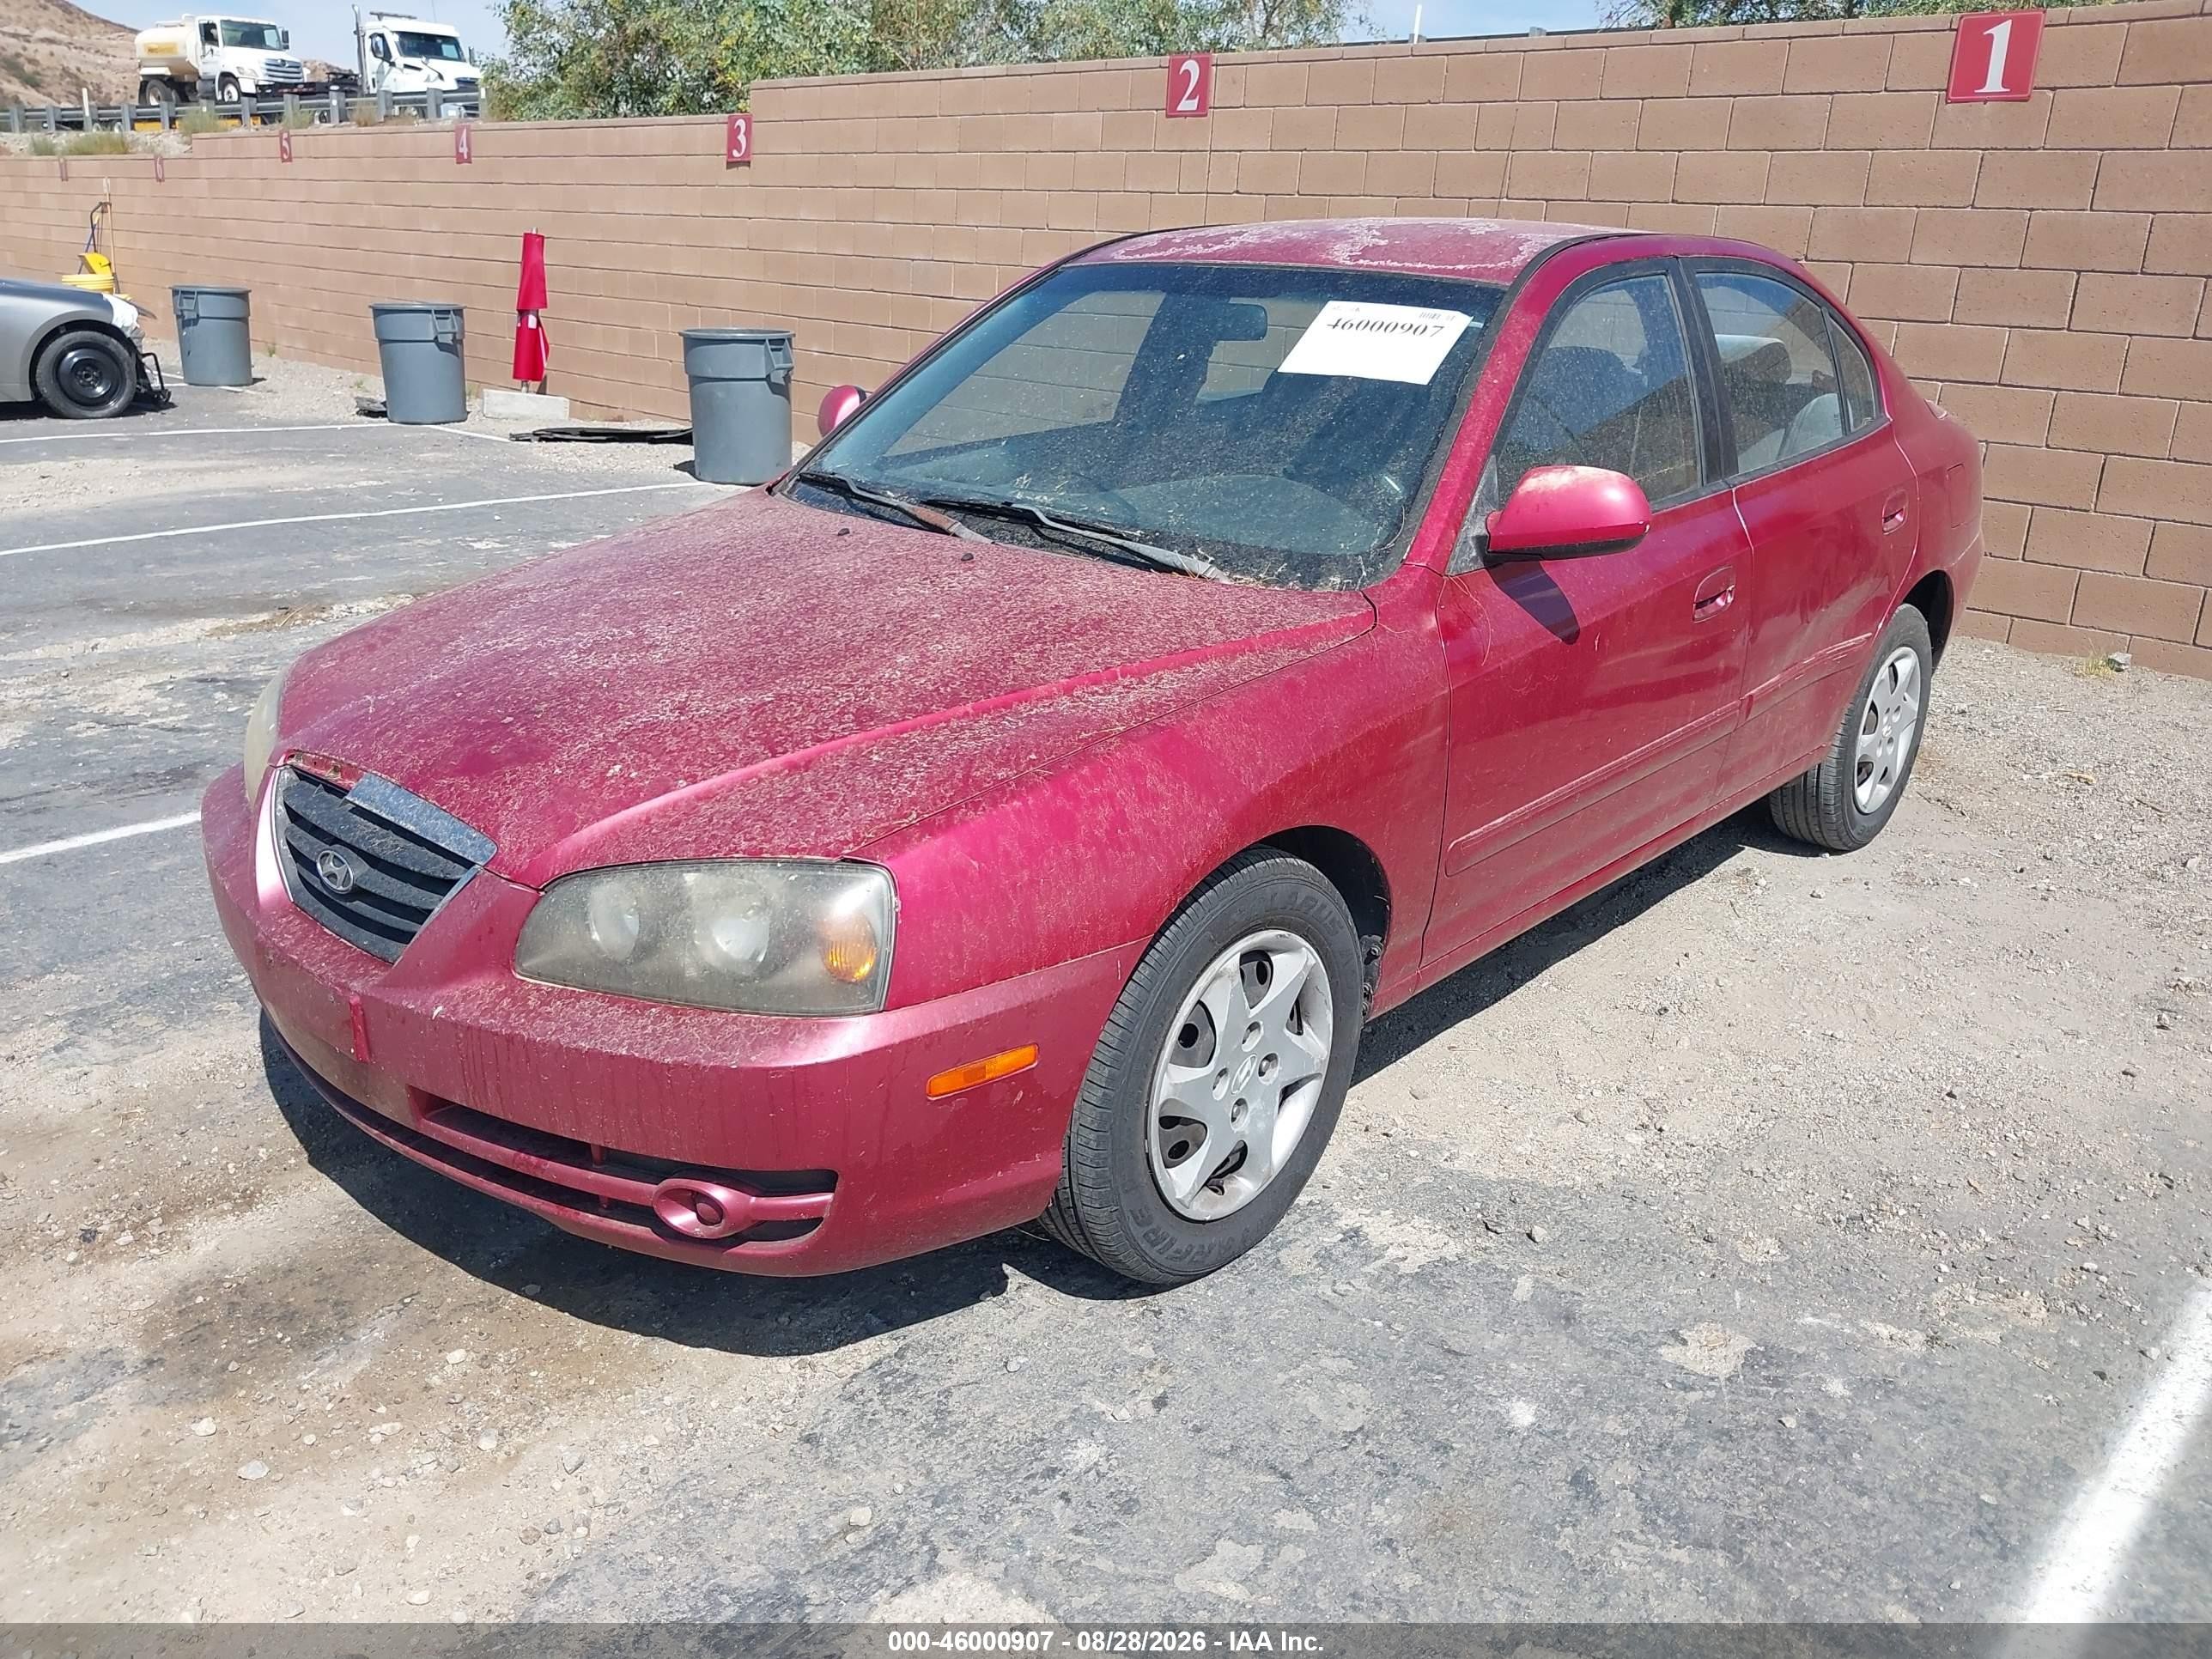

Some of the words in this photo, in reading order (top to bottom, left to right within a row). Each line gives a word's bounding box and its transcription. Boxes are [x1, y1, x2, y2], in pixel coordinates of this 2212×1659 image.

[1974, 19, 2013, 93] 1
[1176, 59, 1200, 111] 2
[282, 132, 289, 159] 5
[459, 127, 468, 159] 4
[732, 118, 747, 157] 3
[1327, 317, 1445, 337] 46000907
